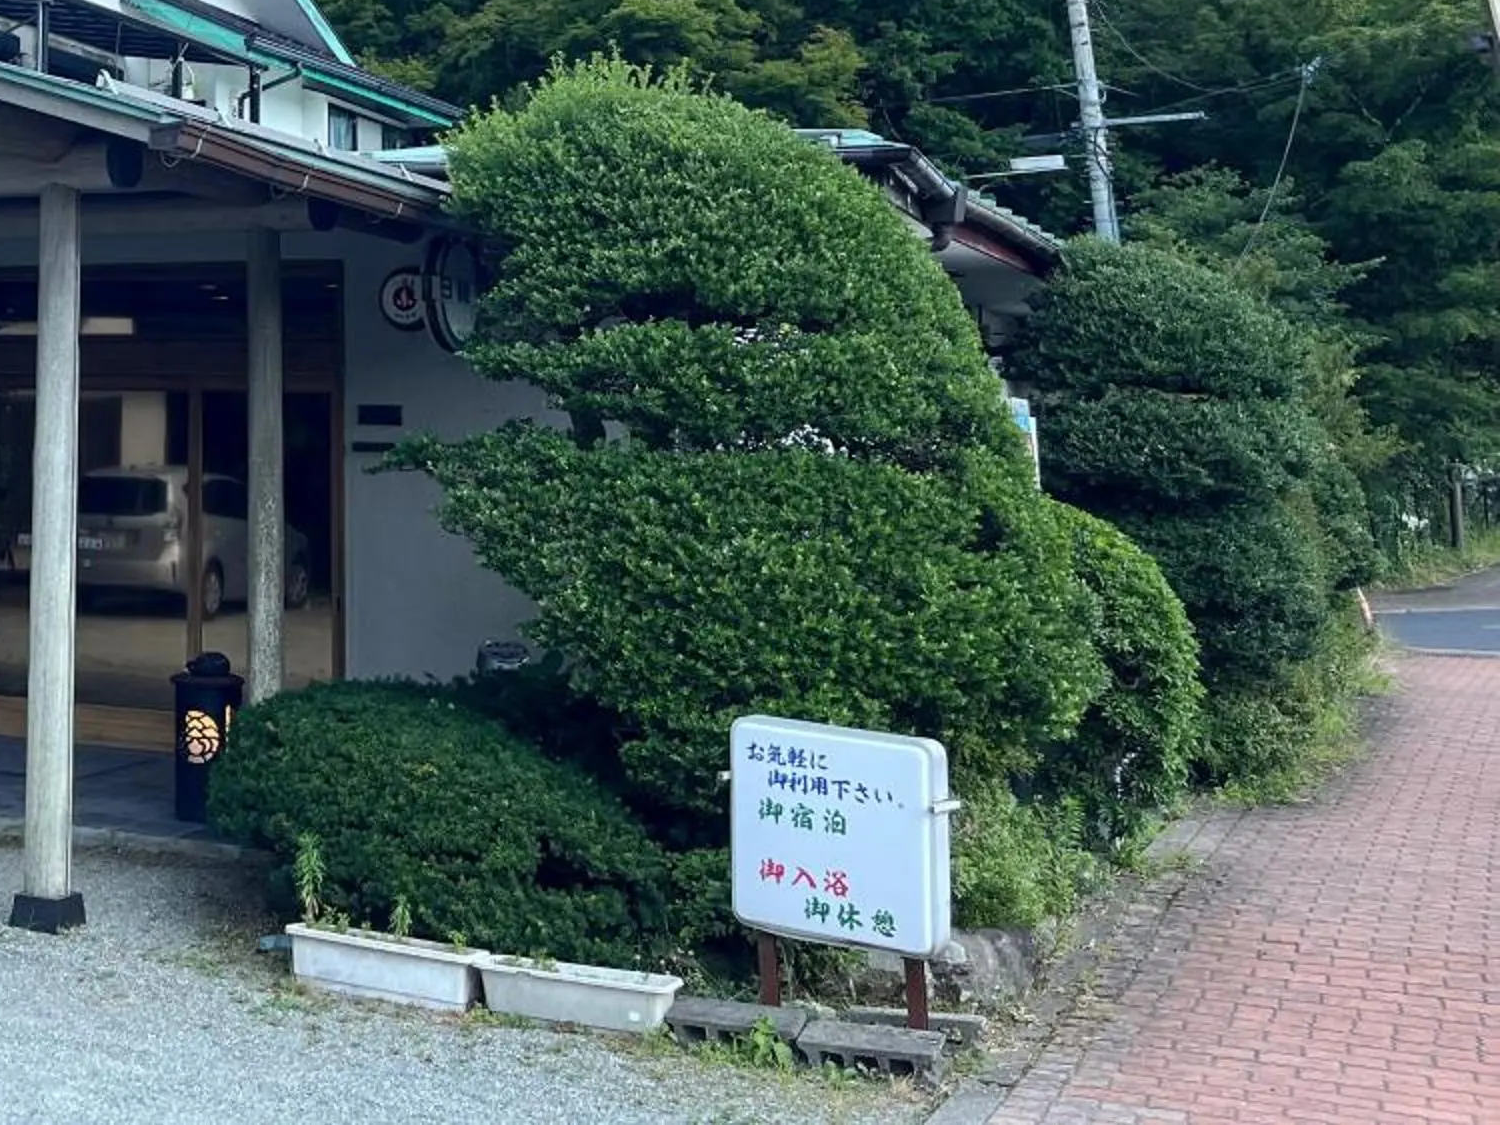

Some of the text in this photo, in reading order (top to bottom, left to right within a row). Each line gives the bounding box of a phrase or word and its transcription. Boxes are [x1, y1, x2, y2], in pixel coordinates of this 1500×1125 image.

[746, 740, 829, 771] お気軽に
[759, 796, 847, 836] 御宿泊
[759, 858, 849, 898] 御入浴
[804, 896, 898, 938] 御休憩
